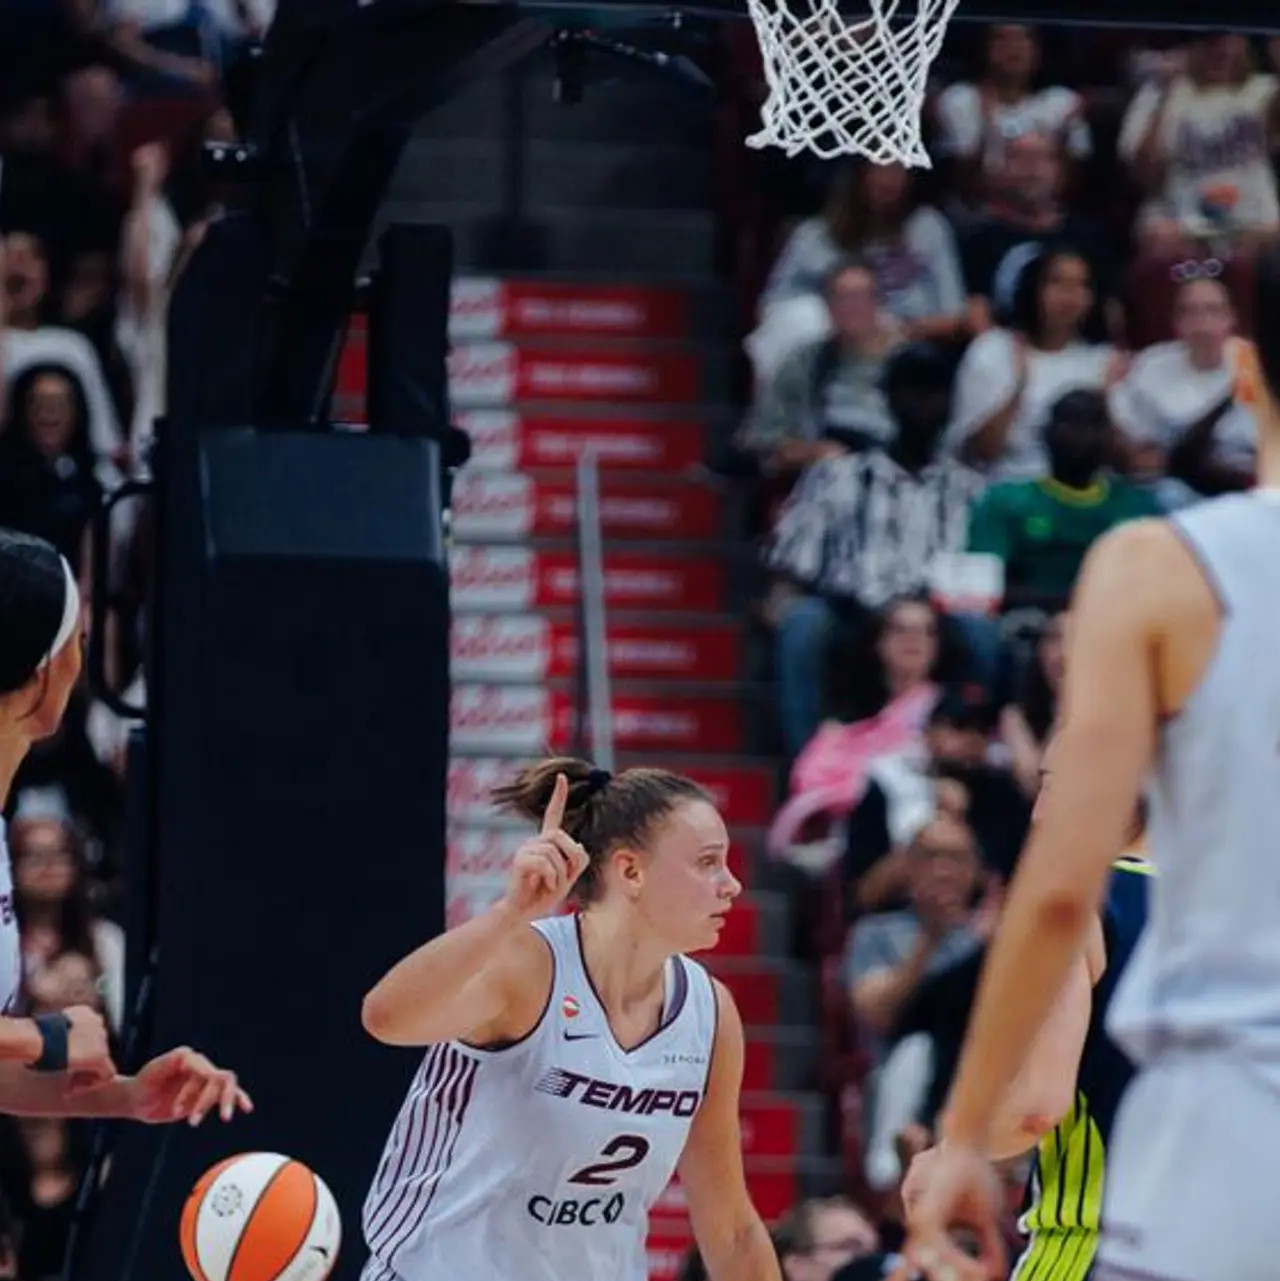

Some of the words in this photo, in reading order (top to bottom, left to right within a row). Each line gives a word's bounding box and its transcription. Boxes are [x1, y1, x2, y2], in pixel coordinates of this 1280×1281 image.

[540, 1067, 699, 1117] TEMPO
[567, 1134, 650, 1185] 2
[528, 1195, 600, 1225] CIBC
